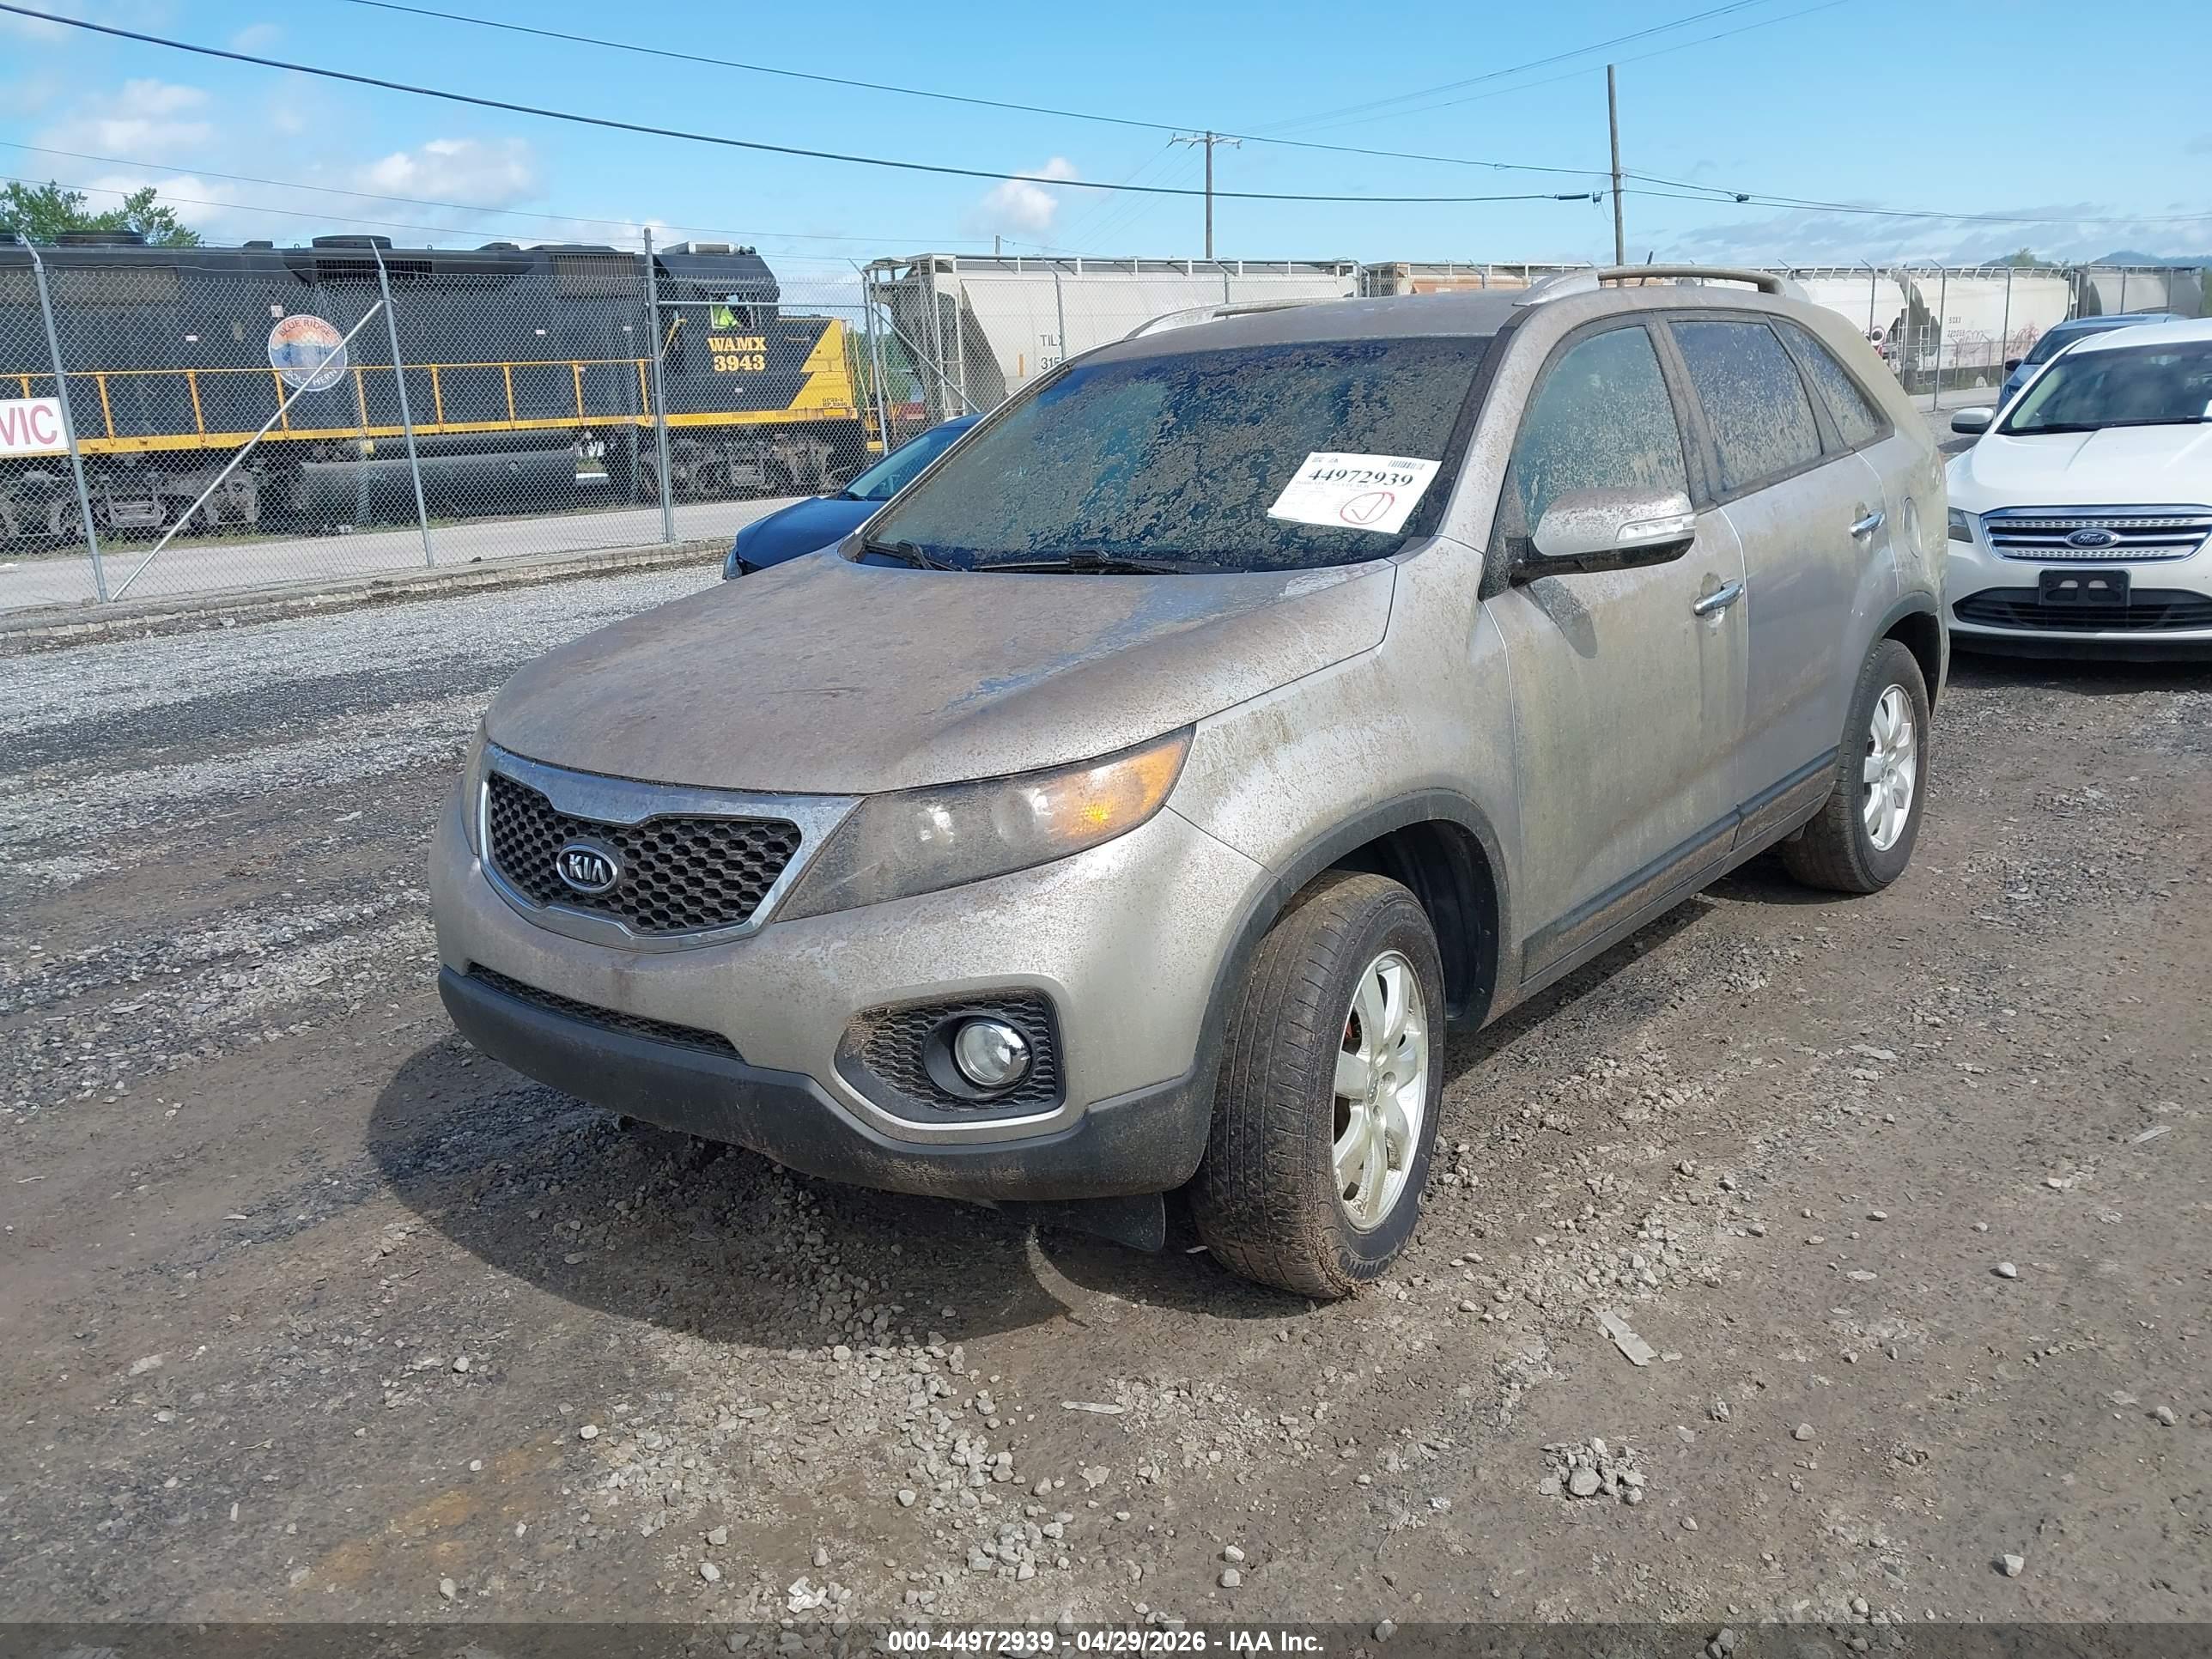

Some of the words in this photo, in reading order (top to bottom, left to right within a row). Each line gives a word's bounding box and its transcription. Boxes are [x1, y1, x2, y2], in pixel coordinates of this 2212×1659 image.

[279, 319, 301, 337] BLUE
[303, 319, 331, 337] RIDGE
[707, 337, 768, 351] WAMX
[714, 355, 765, 371] 3943
[286, 369, 337, 386] SOUHERN
[1308, 468, 1413, 487] 44972939
[568, 854, 608, 884] KIA
